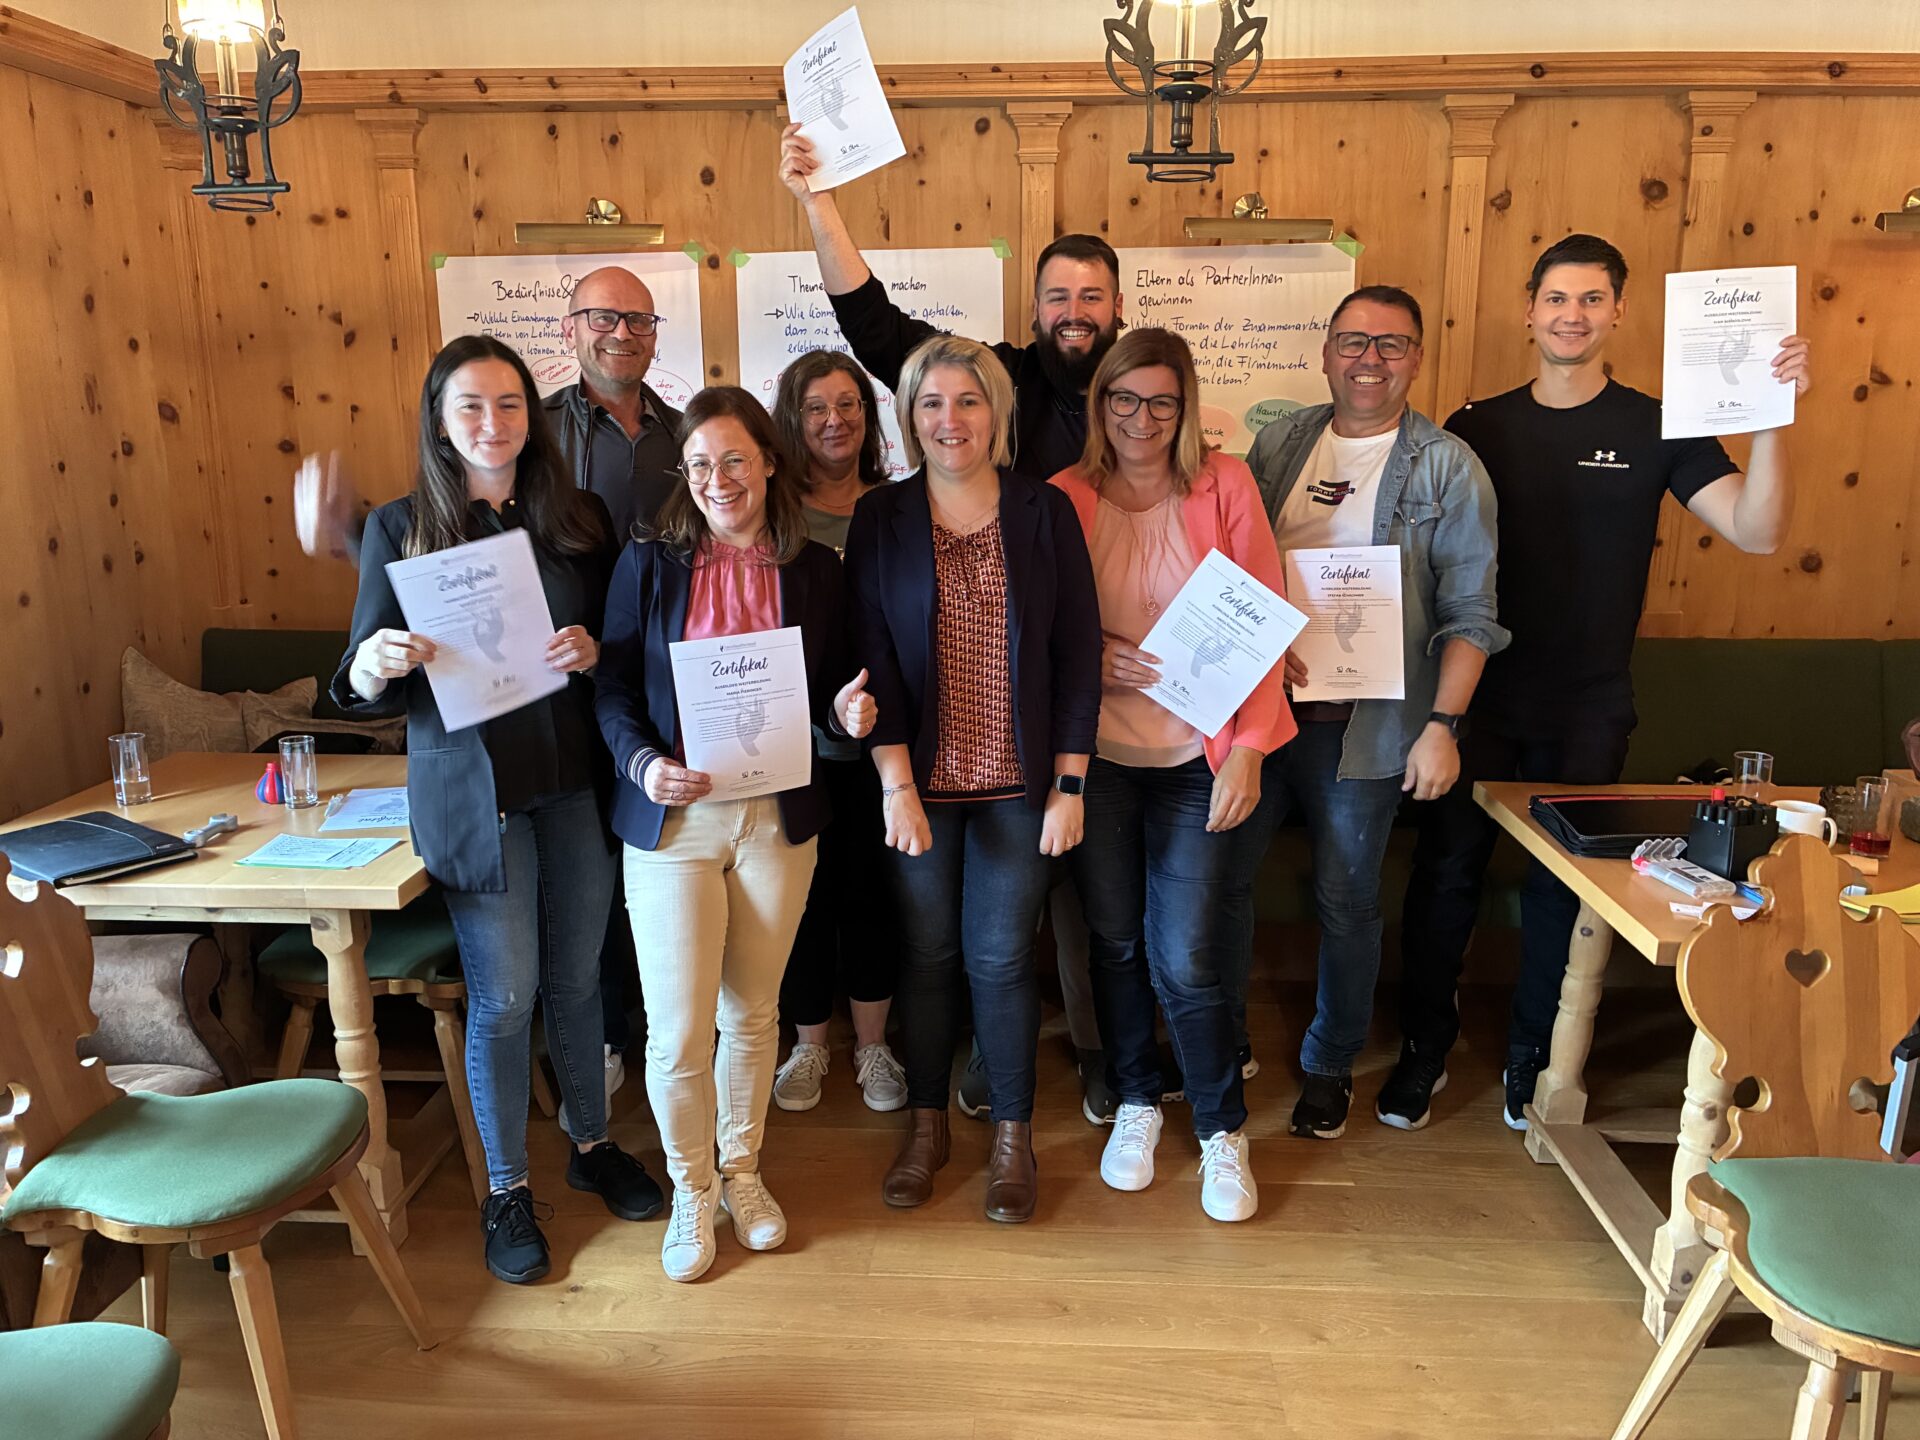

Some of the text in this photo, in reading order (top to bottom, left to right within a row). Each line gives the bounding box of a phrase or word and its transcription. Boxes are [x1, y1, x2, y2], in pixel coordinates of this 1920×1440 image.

[787, 275, 927, 293] Theme machen
[1136, 265, 1283, 288] Eltern als PartnerInnen
[1139, 293, 1193, 319] gewinnen
[1704, 288, 1762, 309] Zertifikat
[784, 302, 805, 320] Wie
[808, 302, 837, 319] könne
[814, 325, 829, 336] sie
[1170, 316, 1209, 331] Formen
[1214, 317, 1234, 332] der
[1242, 316, 1331, 333] Zusammenarbeit
[1200, 335, 1278, 360] die Lehrlinge
[1216, 355, 1233, 369] die
[1236, 353, 1309, 371] Firmenwerte
[1320, 565, 1371, 584] Zertifikat
[1219, 586, 1268, 626] Zertifikat
[711, 656, 769, 679] Zertifikat
